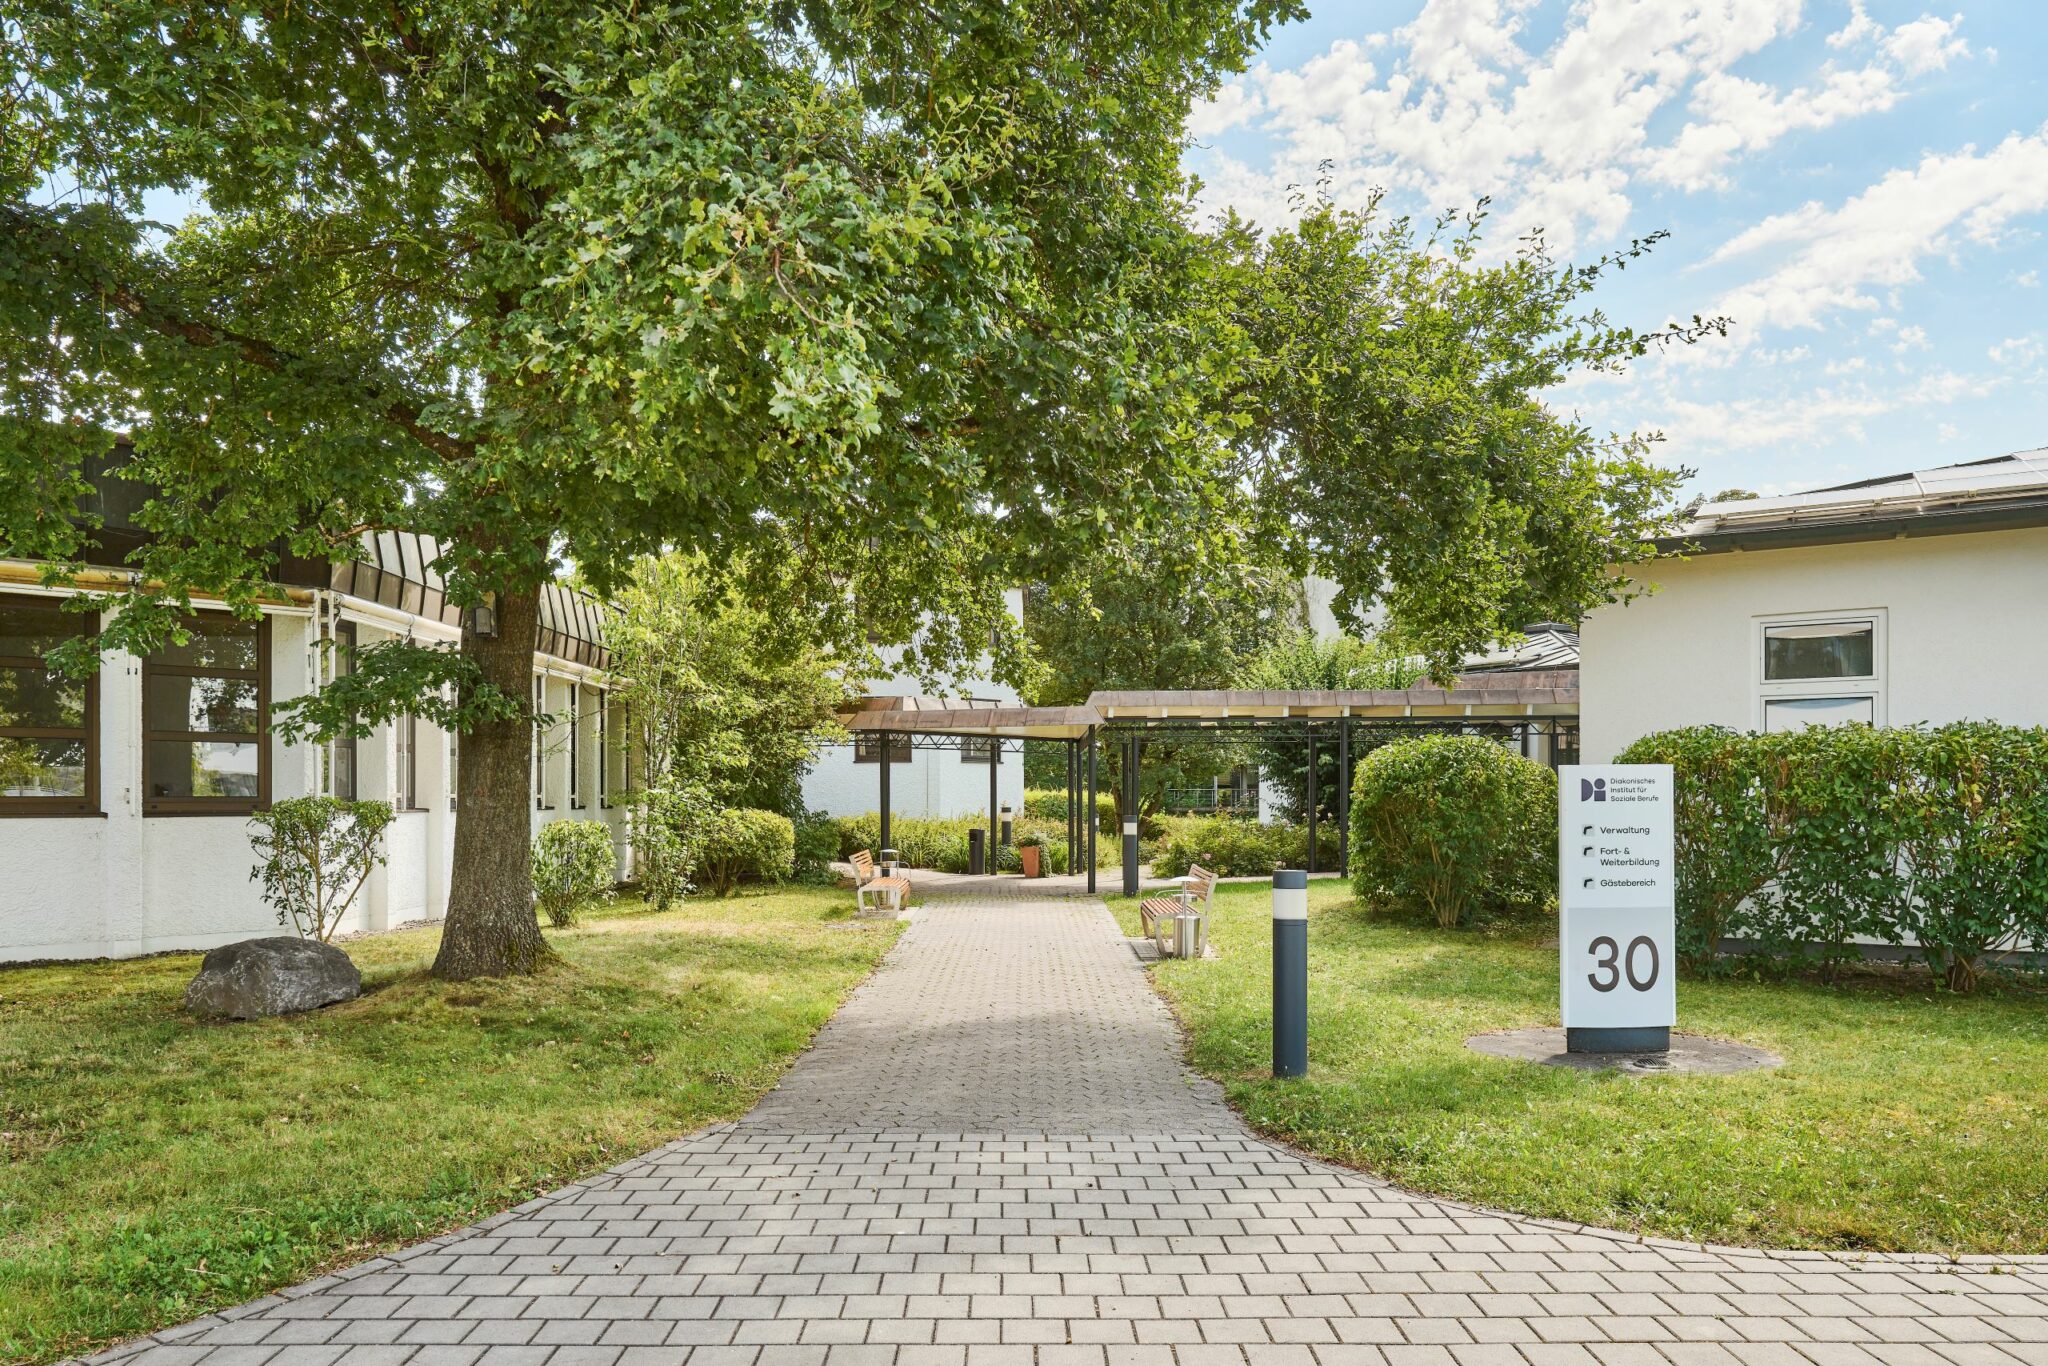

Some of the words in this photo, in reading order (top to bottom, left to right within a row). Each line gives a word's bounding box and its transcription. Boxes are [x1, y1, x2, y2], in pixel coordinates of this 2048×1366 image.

[1600, 826, 1650, 835] Verwaltung
[1600, 858, 1660, 867] Weiterbildung
[1600, 878, 1656, 886] Gästebereich
[1588, 936, 1659, 992] 30
